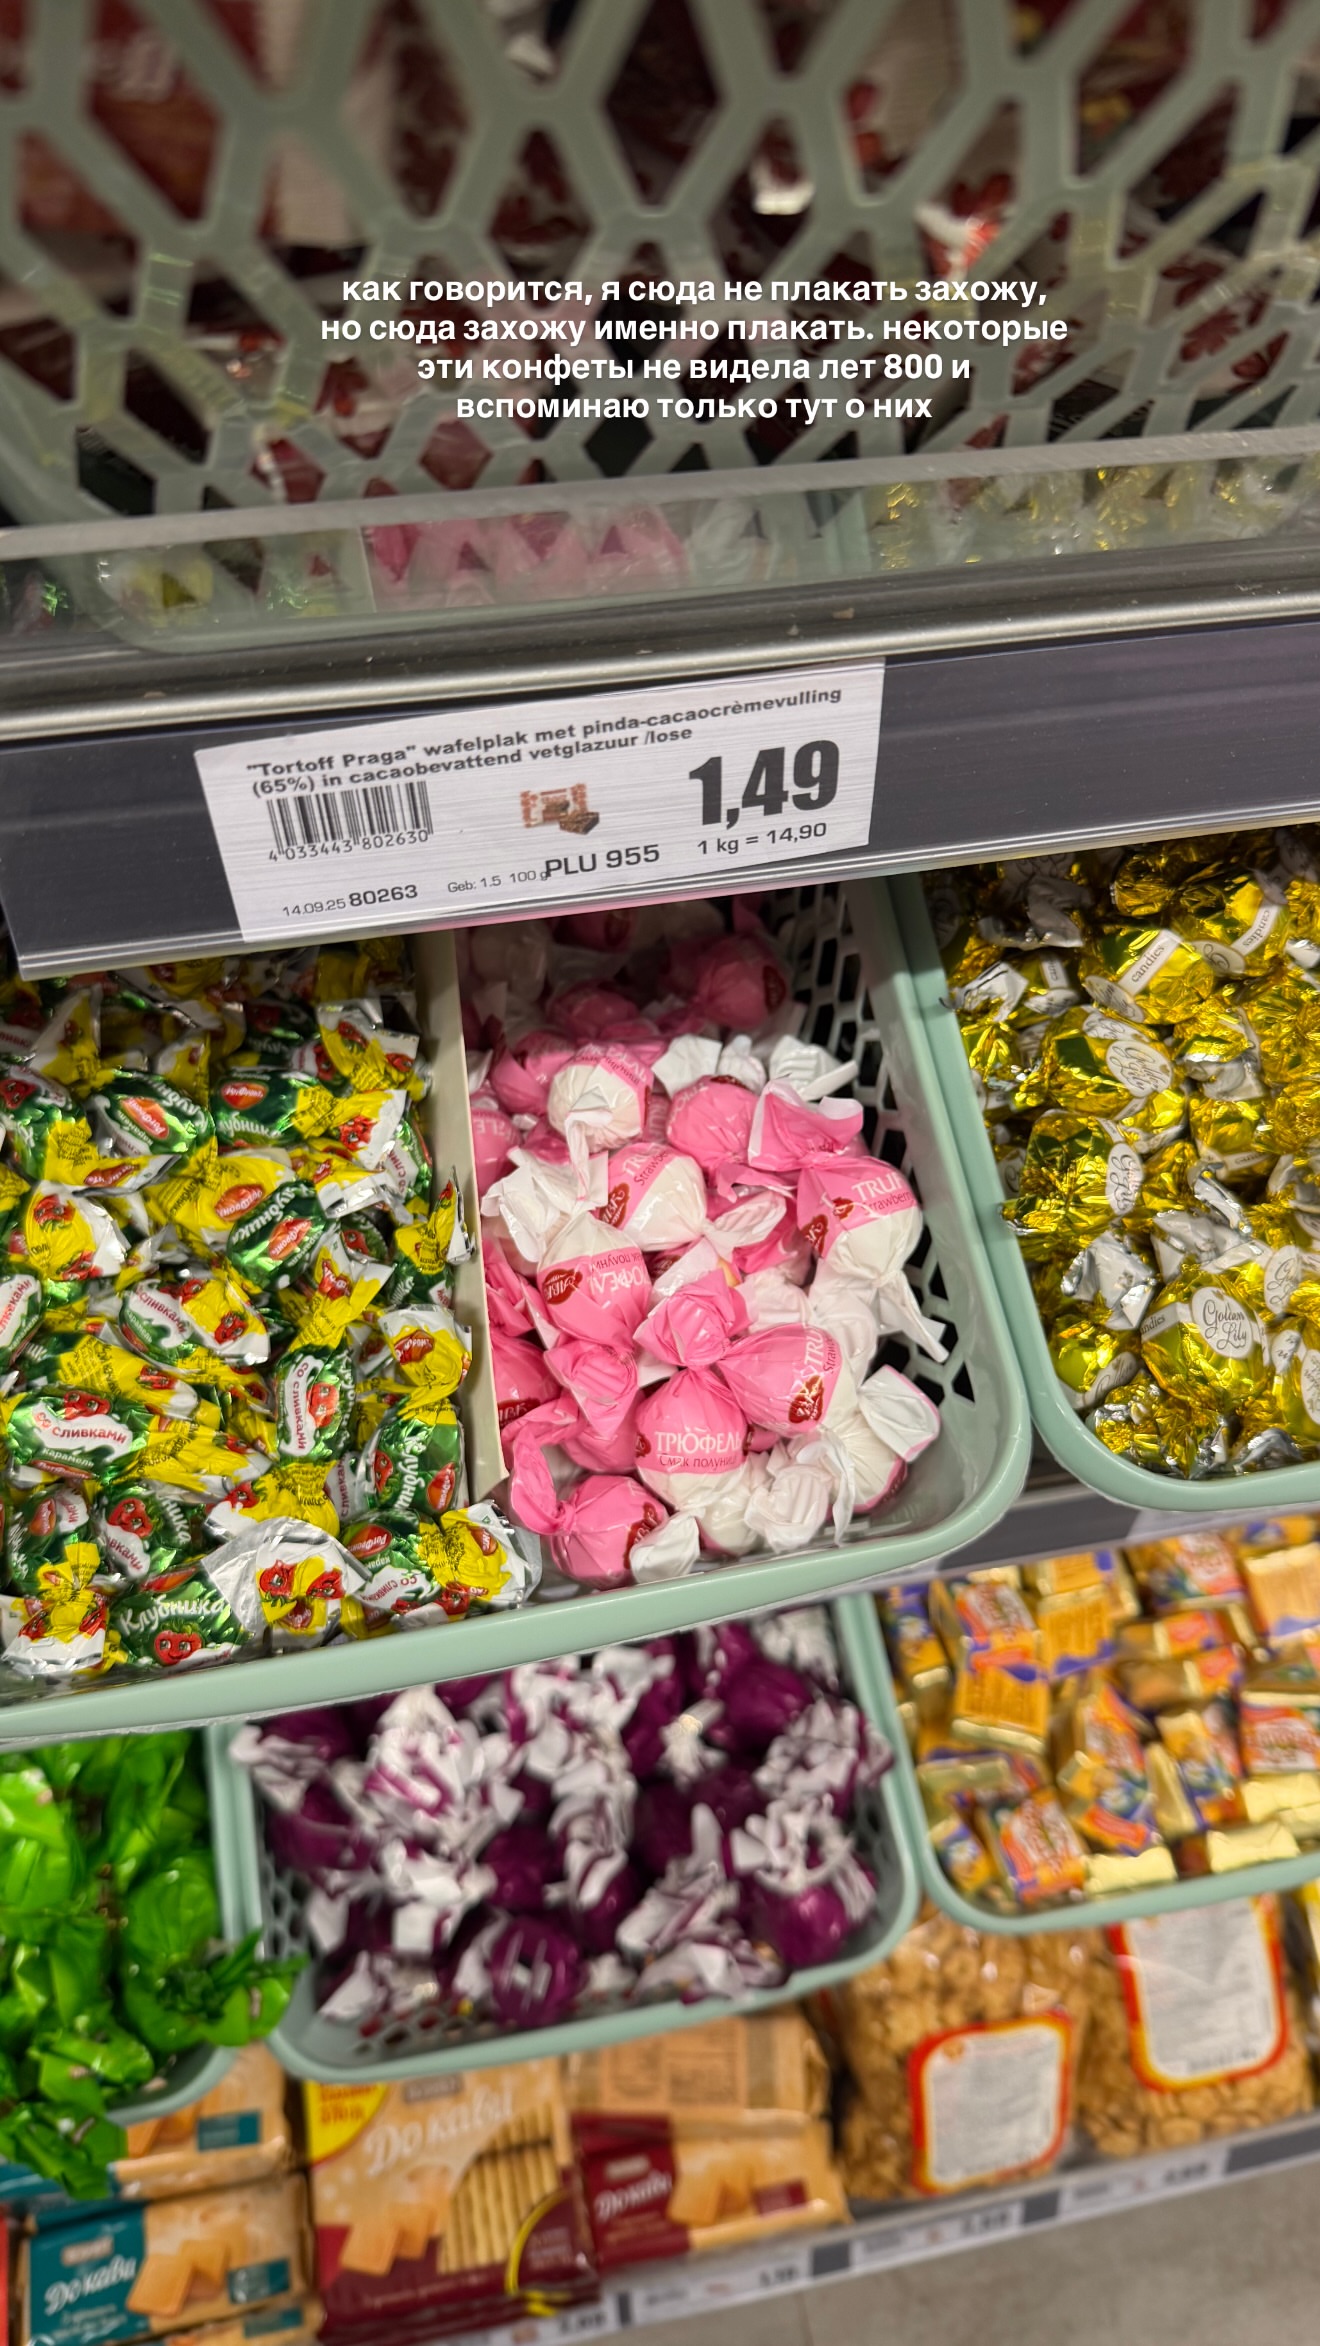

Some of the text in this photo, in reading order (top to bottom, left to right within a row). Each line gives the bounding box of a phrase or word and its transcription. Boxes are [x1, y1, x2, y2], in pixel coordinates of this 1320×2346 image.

[246, 687, 843, 777] "Tortoff Praga" wafelplak met pinda-cacaocrèmevulling
[251, 727, 694, 799] (65%) in cacaobevattend vetglazuur /lose
[688, 739, 841, 831] 1,49
[696, 821, 828, 856] 1 kg = 14,90
[509, 869, 538, 885] 100
[545, 843, 661, 879] PLU 955
[282, 883, 419, 918] 14.09.25 80263
[1130, 943, 1166, 984] candies
[1202, 1298, 1245, 1340] Golden
[1216, 1321, 1248, 1351] Lily
[52, 1425, 128, 1445] сливками
[292, 1380, 308, 1450] сливками
[120, 1592, 230, 1636] Клубника
